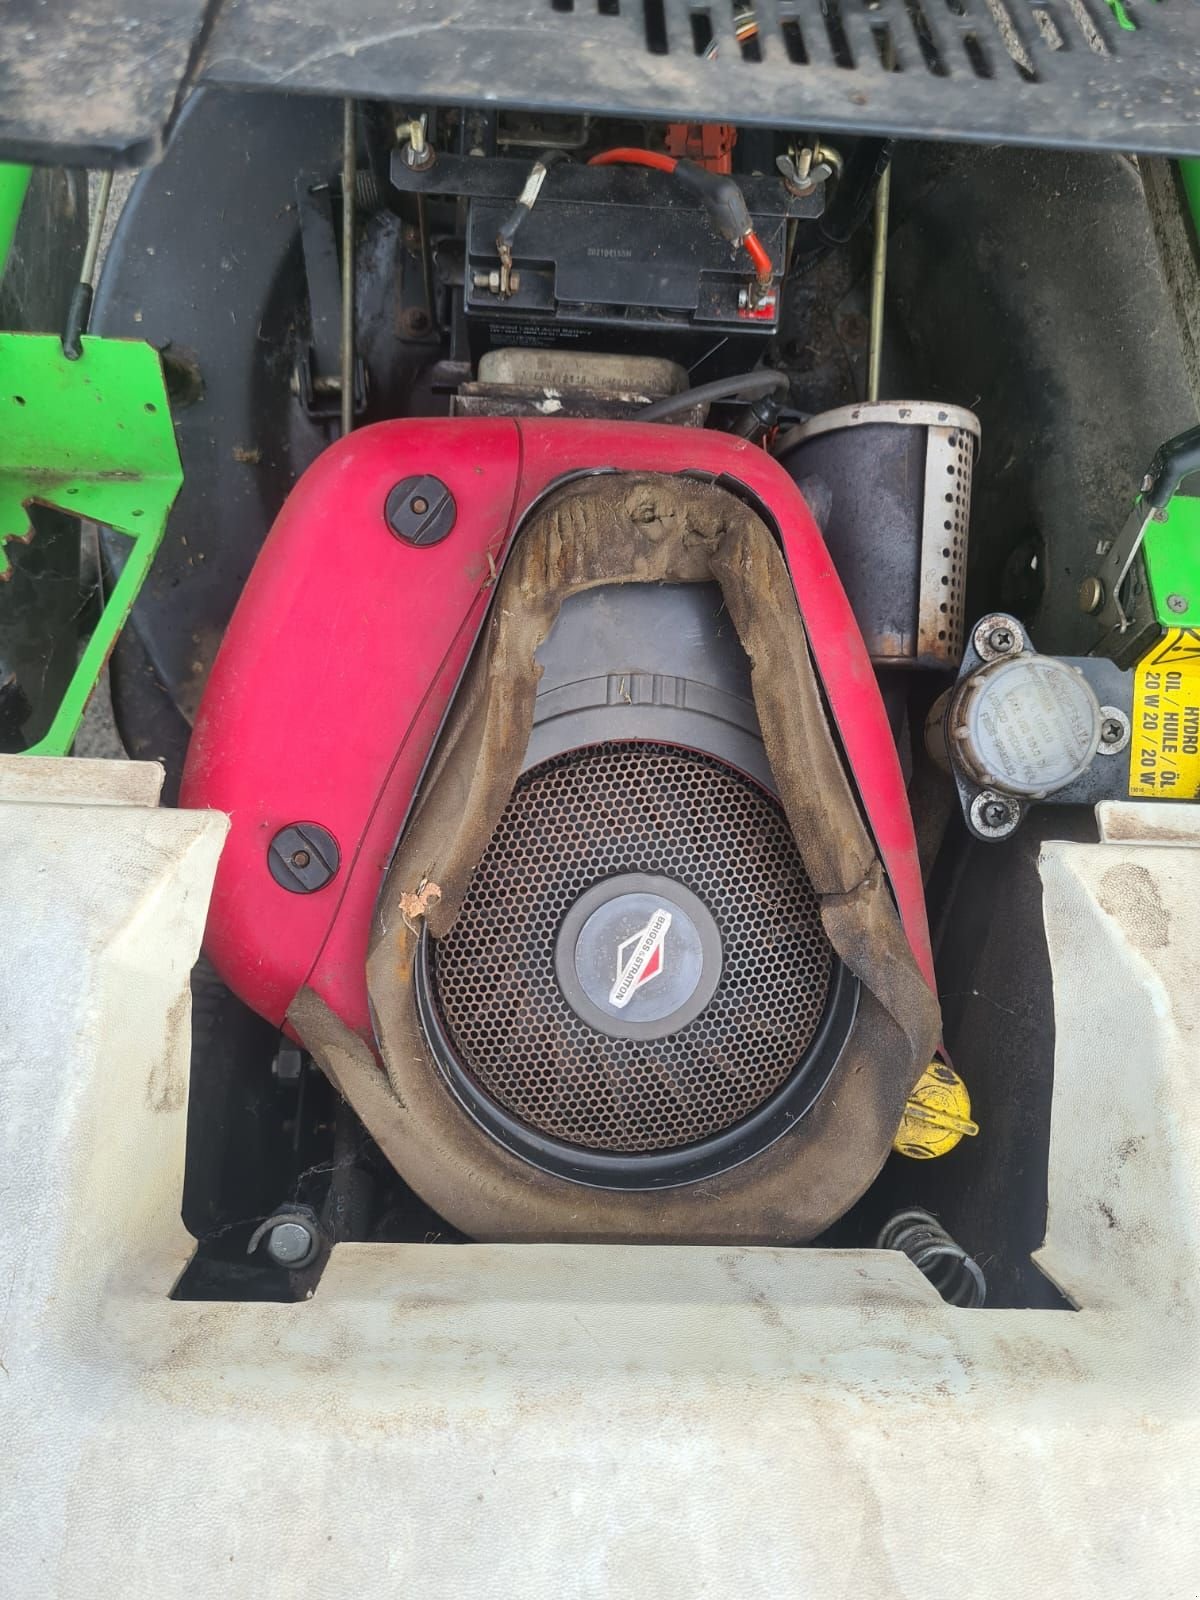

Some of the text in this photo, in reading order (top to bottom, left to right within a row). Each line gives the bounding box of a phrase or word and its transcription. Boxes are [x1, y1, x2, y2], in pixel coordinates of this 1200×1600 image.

[1140, 672, 1161, 787] 20 W 20 / 20 W
[1160, 671, 1182, 788] OIL / HUILE / ÖL
[1182, 706, 1199, 754] HYDRO
[642, 916, 665, 952] BRIGGS
[615, 956, 645, 1000] STRATTON
